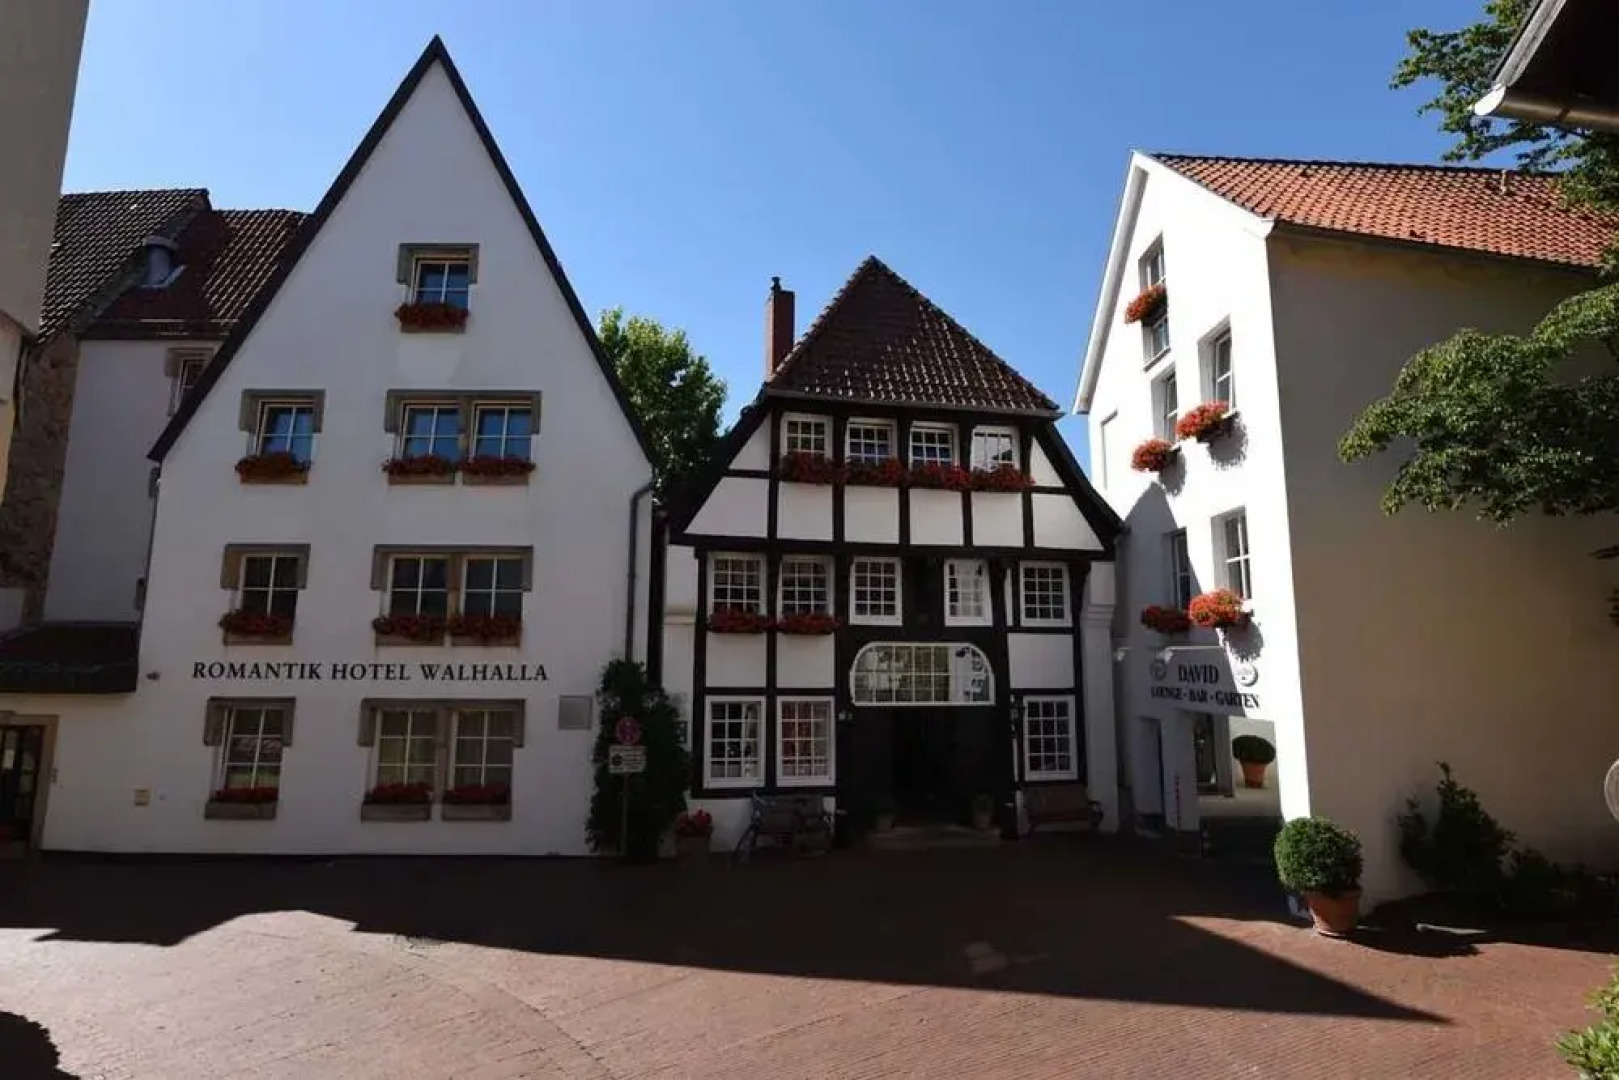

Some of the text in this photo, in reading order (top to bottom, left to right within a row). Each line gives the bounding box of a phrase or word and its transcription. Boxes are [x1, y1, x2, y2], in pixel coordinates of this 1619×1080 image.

[193, 661, 548, 681] ROMANTIK HOTEL WALHALLA
[1178, 664, 1219, 684] DAVID
[1189, 688, 1208, 704] BAR
[1215, 691, 1260, 708] GARTEN
